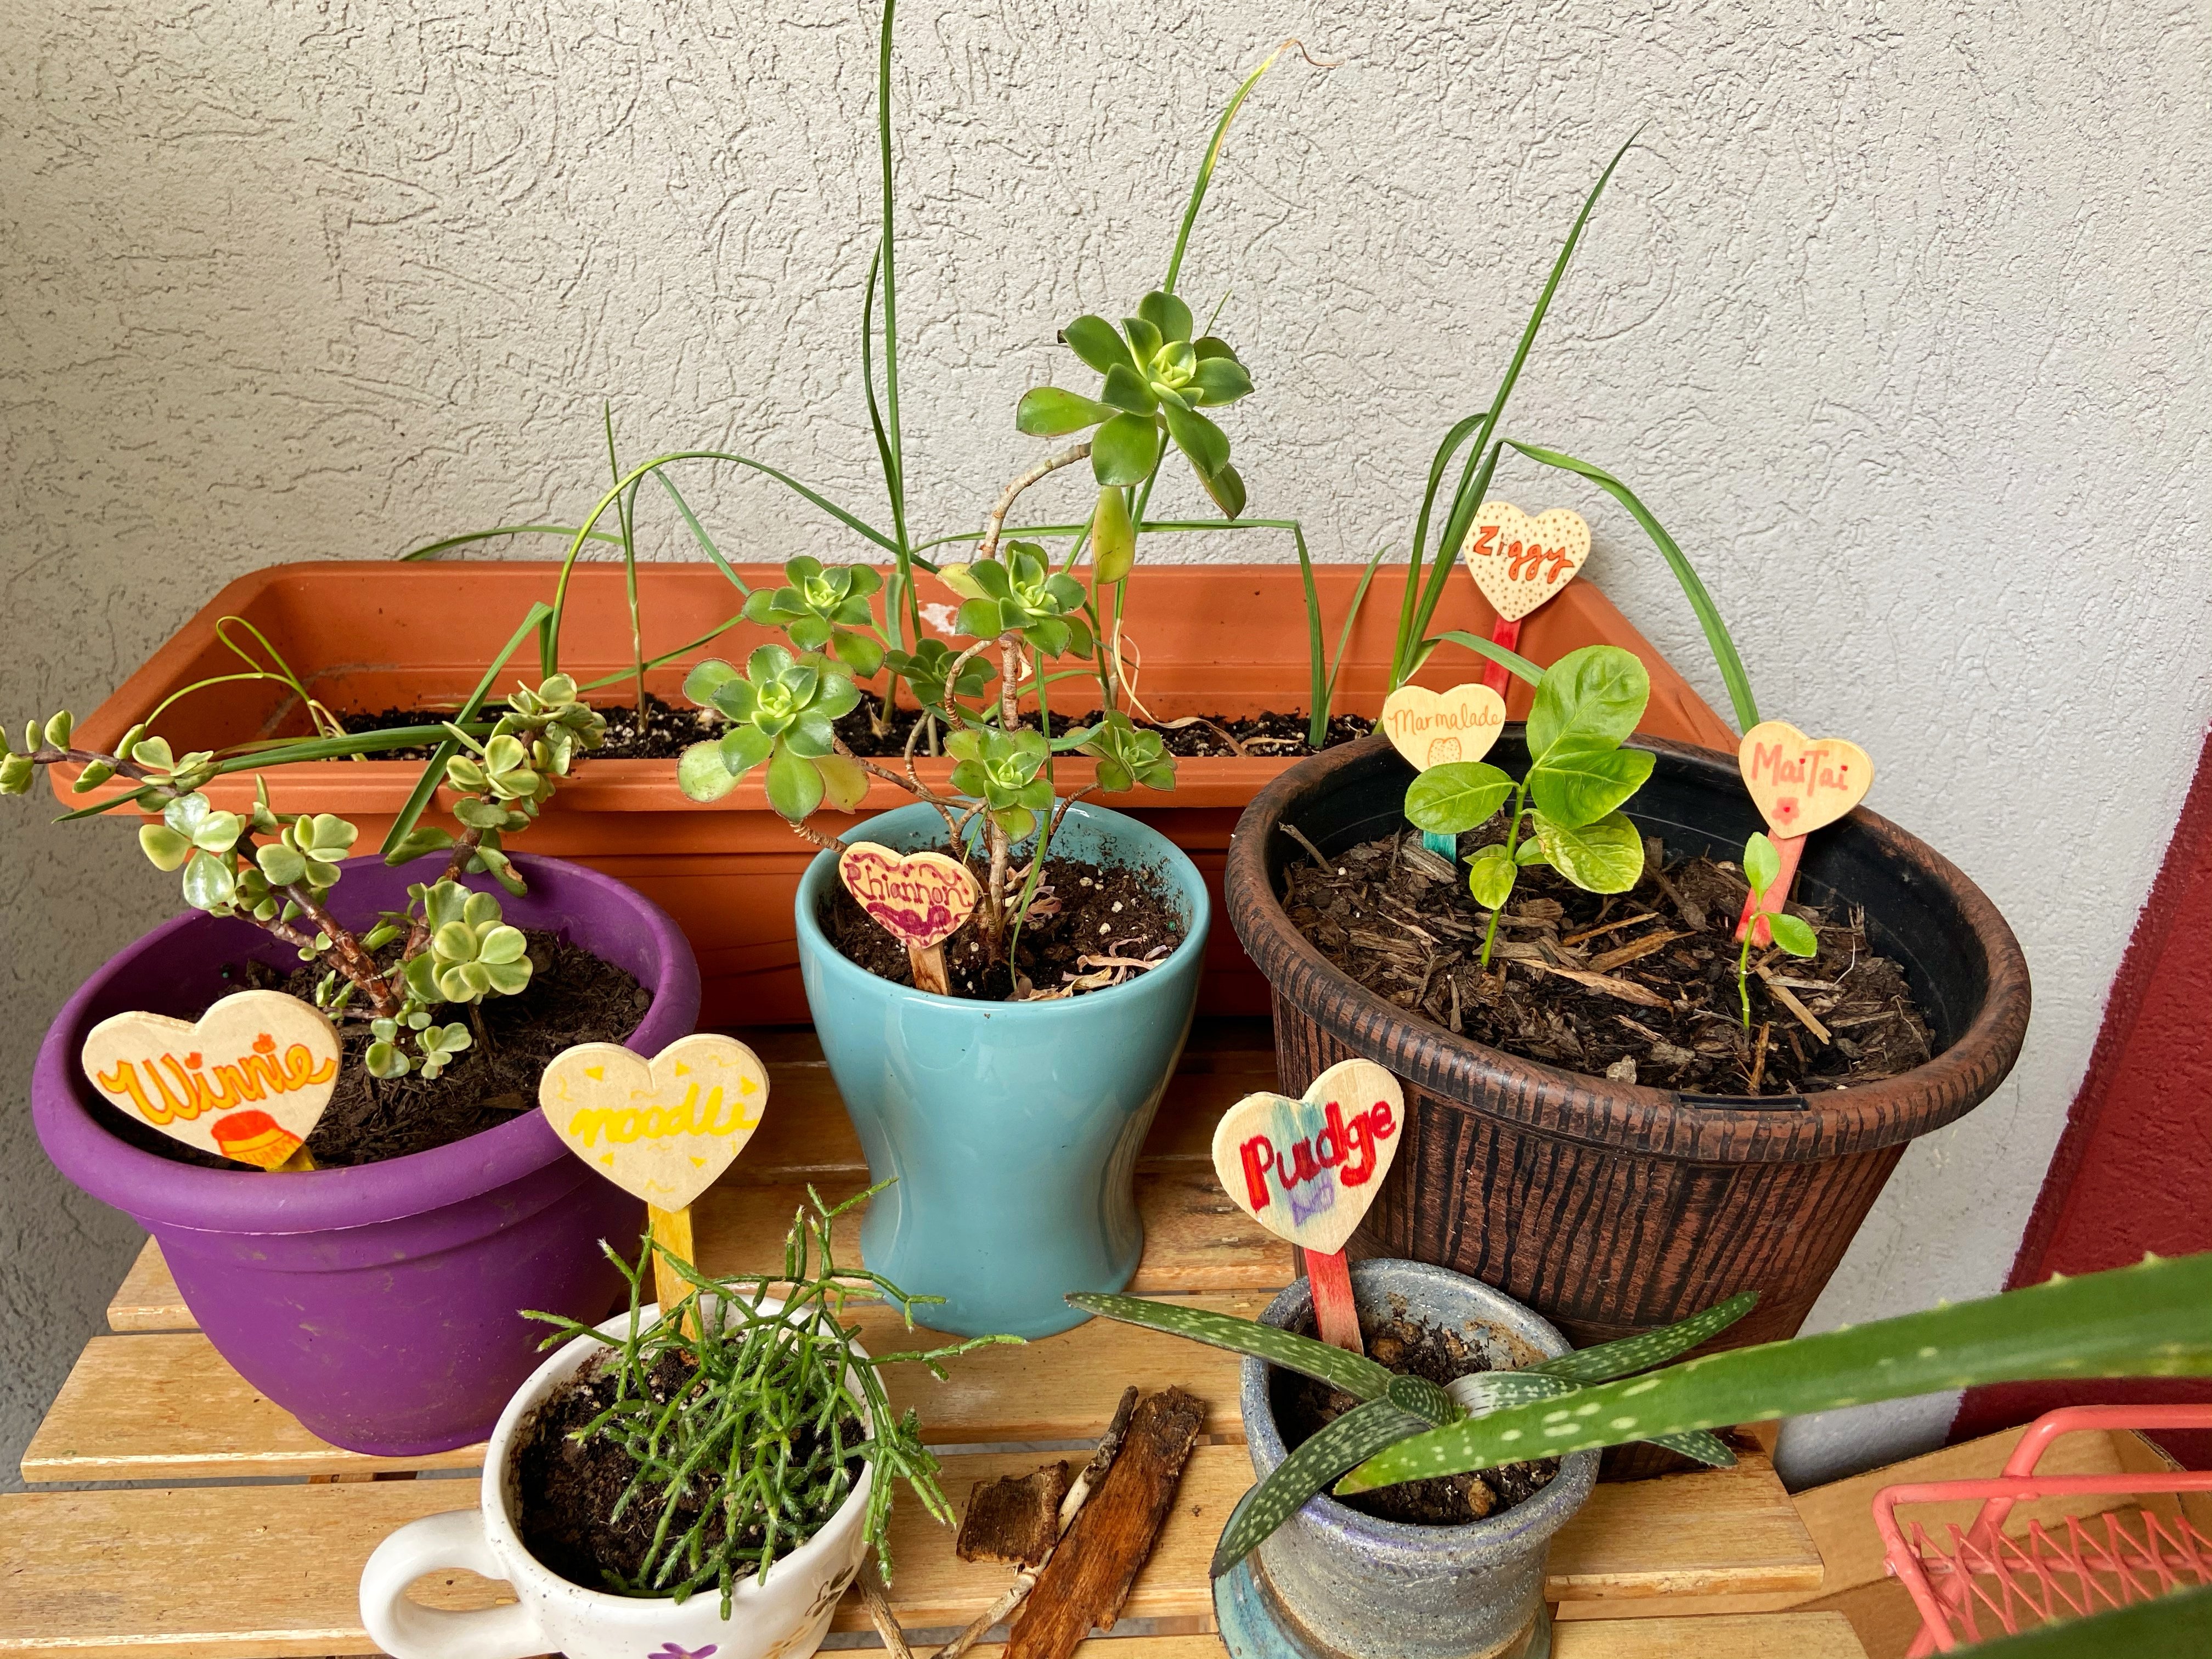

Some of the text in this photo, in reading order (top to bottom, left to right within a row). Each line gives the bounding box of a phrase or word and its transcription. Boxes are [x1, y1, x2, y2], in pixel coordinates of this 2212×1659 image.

[1473, 526, 1575, 584] Ziggy
[1388, 703, 1502, 739] Marmalade
[843, 862, 974, 907] Rhiannon
[98, 1032, 337, 1125] Winnie
[1239, 1100, 1397, 1214] Pudge
